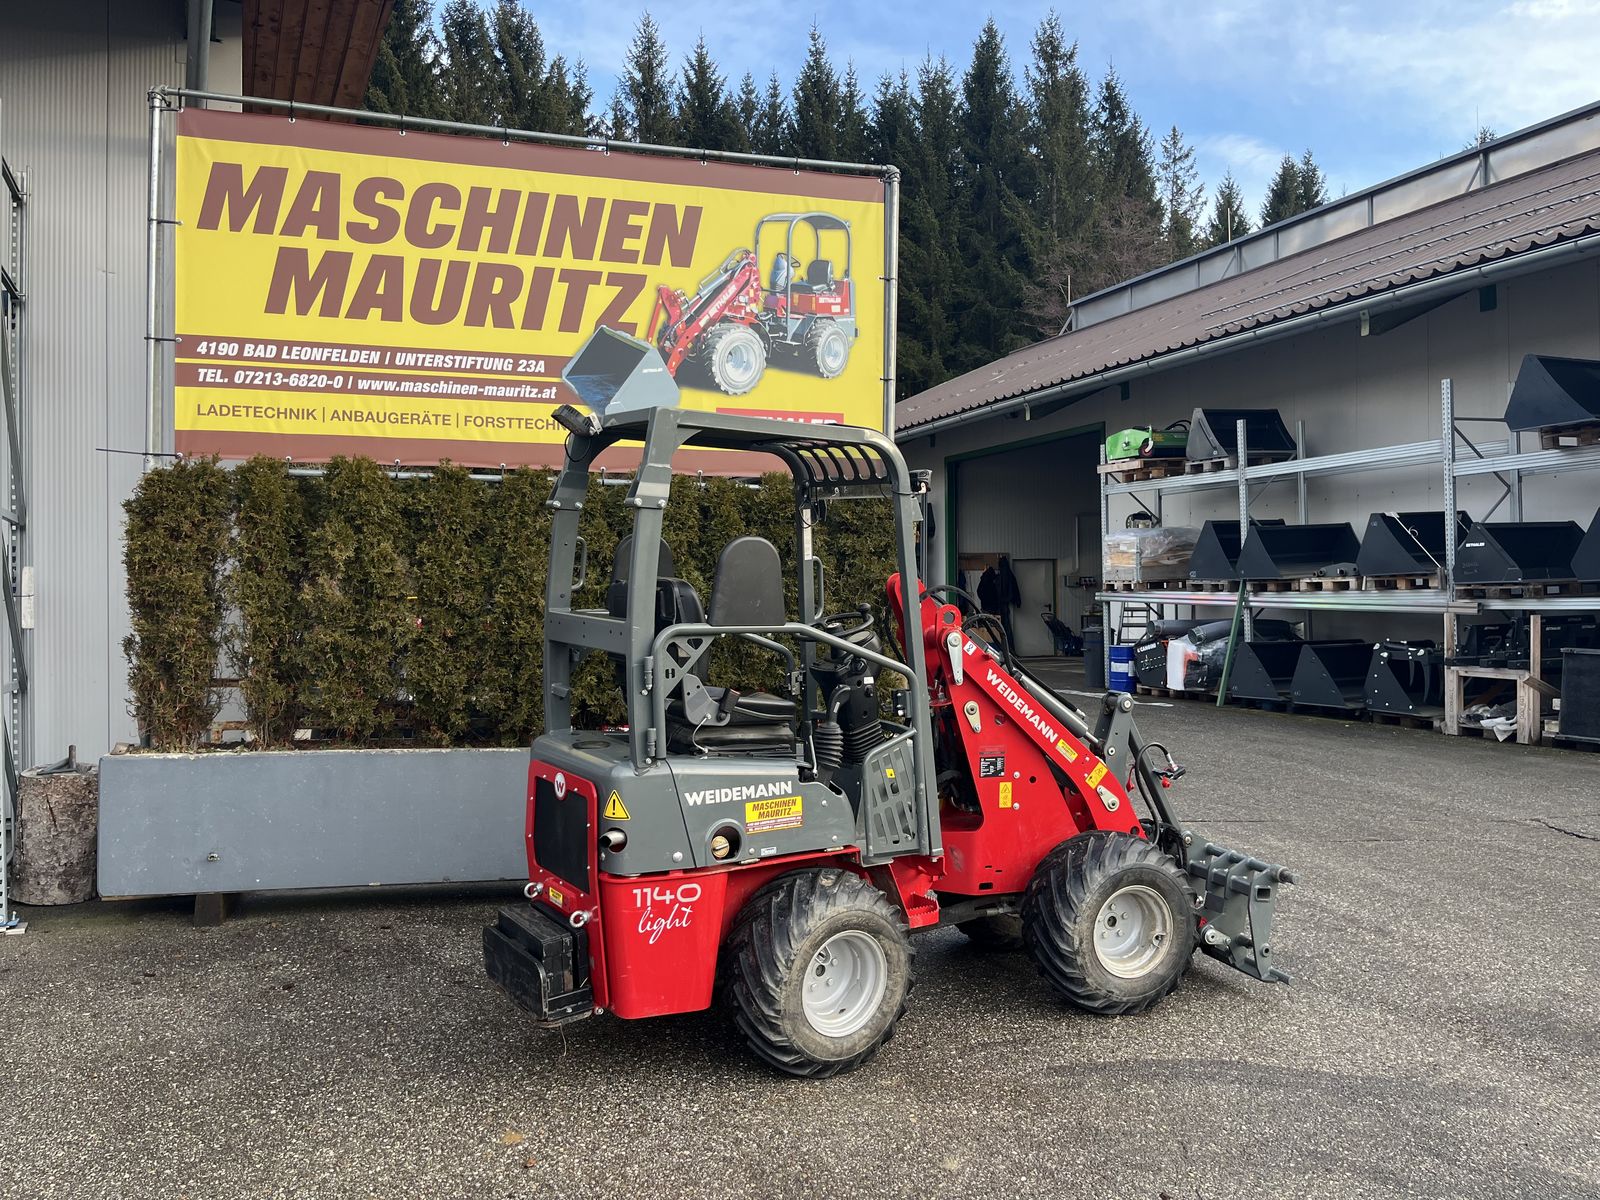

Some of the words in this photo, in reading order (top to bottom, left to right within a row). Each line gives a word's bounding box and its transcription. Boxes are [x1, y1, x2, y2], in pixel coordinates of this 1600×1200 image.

[196, 161, 703, 268] MASCHINEN
[264, 246, 647, 335] MAURITZ
[197, 341, 239, 356] 4190
[243, 343, 277, 358] BAD
[281, 345, 381, 364] LEONFELDEN
[395, 352, 513, 371] UNTERSTIFTUNG
[517, 359, 545, 373] 23A
[197, 368, 228, 383] TEL.
[234, 370, 343, 388] 07213-6820-0
[357, 379, 557, 399] www.maschinen-mauritz.at
[197, 404, 318, 421] LADETECHNIK
[330, 409, 452, 426] ANBAUGERÄTE
[986, 668, 1058, 743] WEIDEMANN
[556, 781, 565, 794] W
[684, 781, 793, 806] WEIDEMANN
[752, 798, 797, 812] MASCHINEN
[757, 807, 792, 819] MAURITZ
[632, 883, 702, 908] 1140
[638, 903, 693, 944] light
